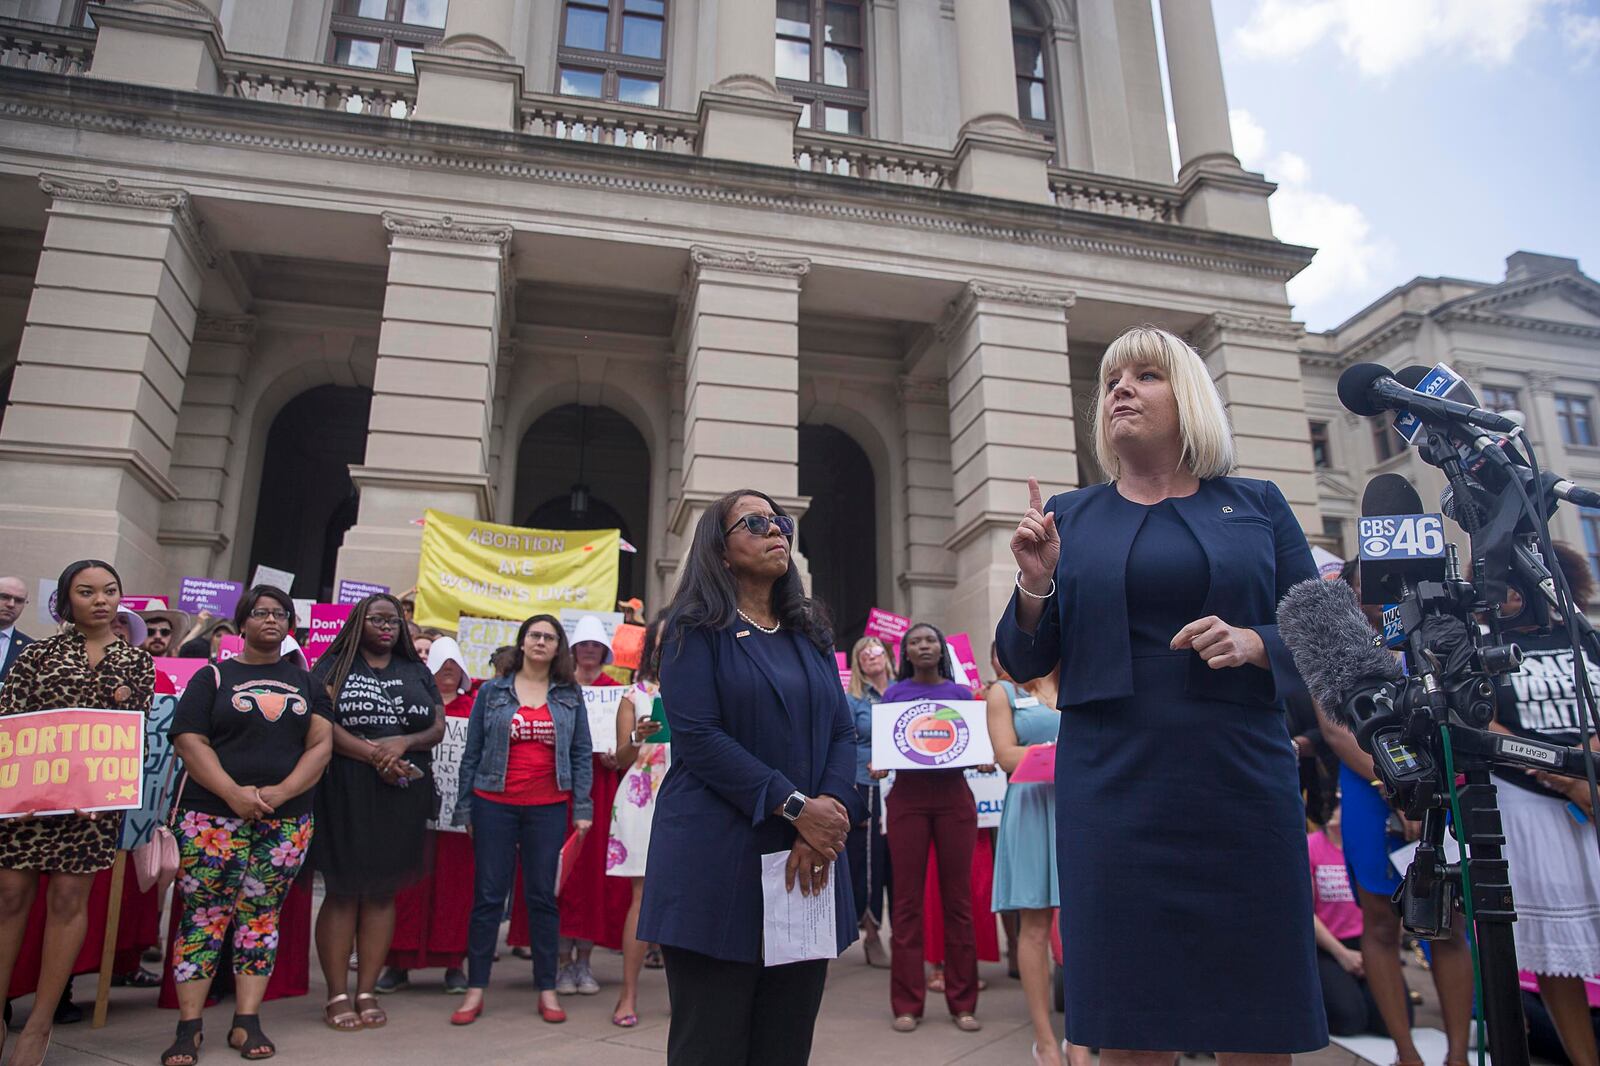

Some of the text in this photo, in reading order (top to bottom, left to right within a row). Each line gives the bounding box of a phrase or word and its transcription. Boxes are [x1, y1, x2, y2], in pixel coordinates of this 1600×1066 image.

[467, 527, 565, 553] ABORTION
[1360, 517, 1444, 556] CBS 46
[183, 587, 218, 596] Freedom
[184, 579, 235, 591] Reproductive
[341, 589, 370, 597] Freedom
[342, 581, 384, 594] Reproductive
[439, 572, 530, 601] WOMEN'S
[344, 681, 382, 694] LOVES
[339, 701, 430, 716] WHO HAD AN
[894, 704, 937, 753] PRO-CHOICE
[0, 724, 137, 760] BORTION
[934, 727, 968, 764] PEACHES
[1510, 744, 1548, 760] GEAR #11
[33, 759, 70, 785] DO
[84, 757, 140, 783] YOU
